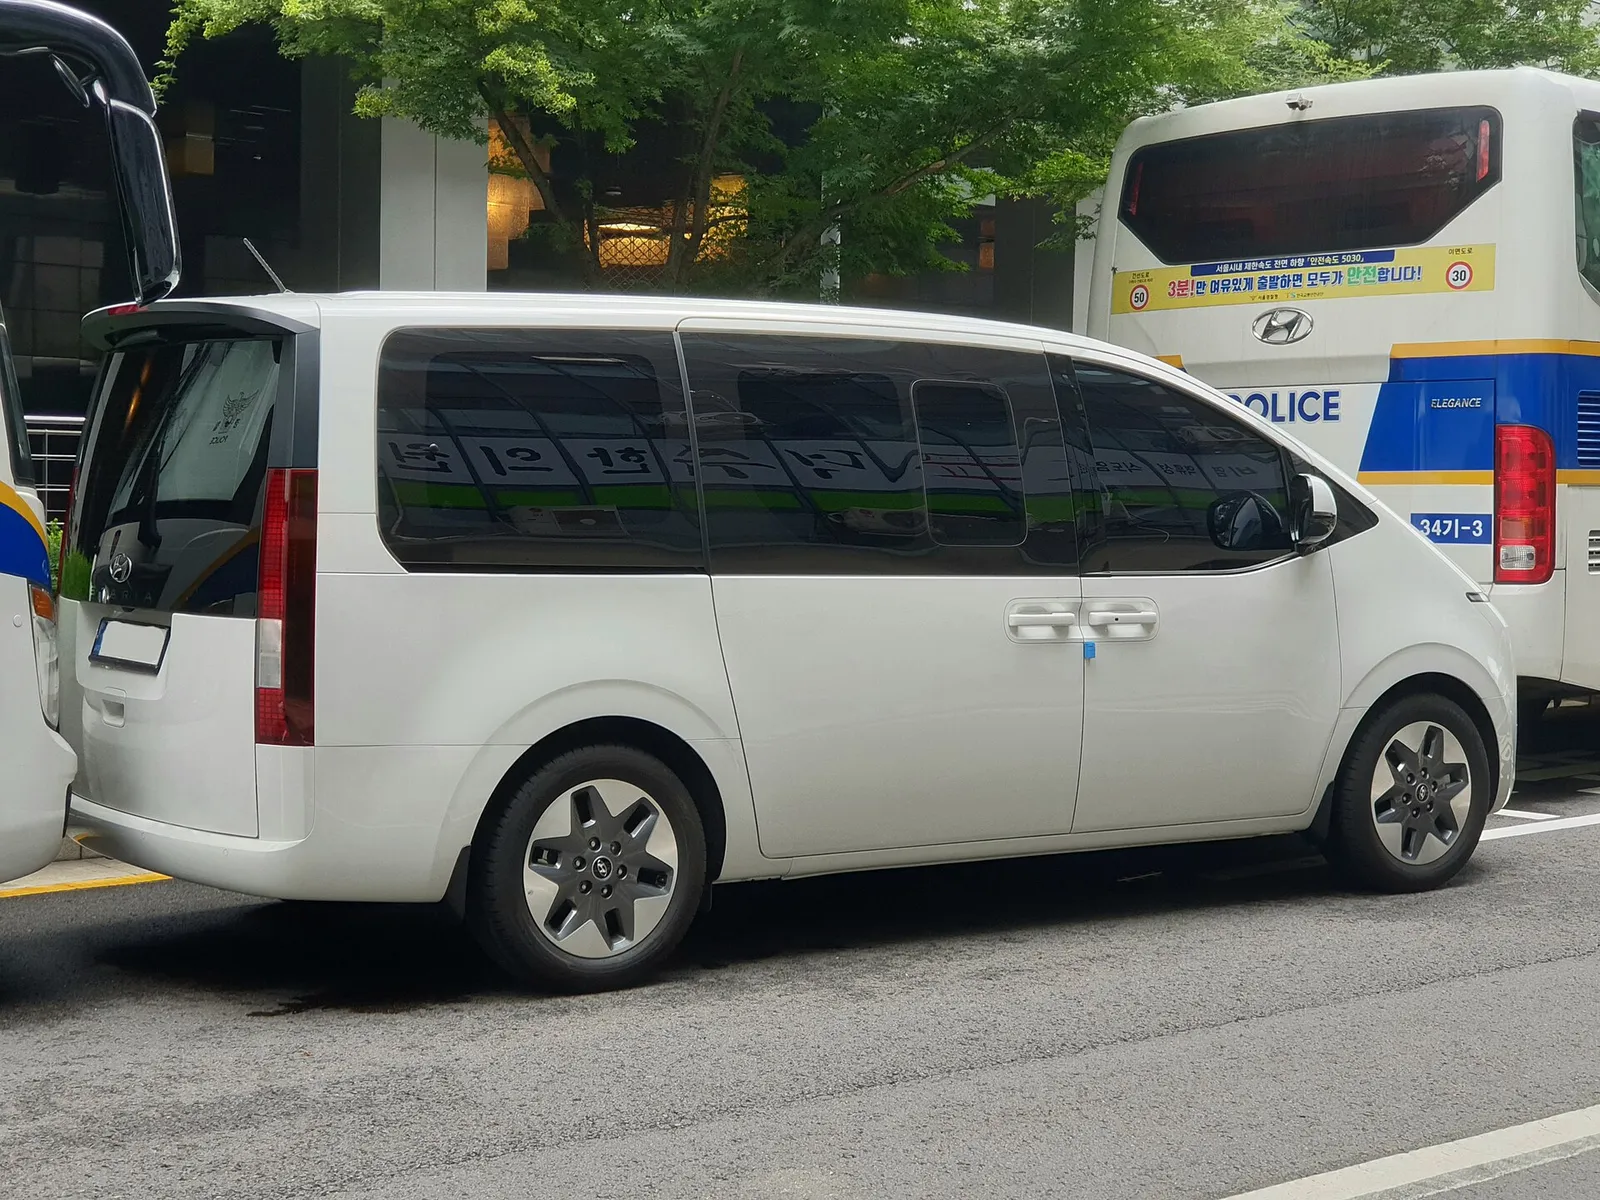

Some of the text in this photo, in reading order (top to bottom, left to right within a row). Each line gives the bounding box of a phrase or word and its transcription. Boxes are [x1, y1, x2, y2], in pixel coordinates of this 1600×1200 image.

[1215, 263, 1243, 274] 서울시내
[1244, 260, 1273, 271] 제한속도
[1274, 258, 1289, 269] 전면
[1290, 257, 1304, 268] 하향
[1210, 277, 1254, 295] 여유있게
[1257, 273, 1303, 291] 출발하면
[1307, 270, 1344, 287] 모두가
[1346, 265, 1423, 285] 안전합니다!
[1451, 269, 1467, 283] 30
[1133, 292, 1145, 304] 50
[1430, 397, 1482, 410] ELEGANCE
[1418, 518, 1485, 540] 34기-3
